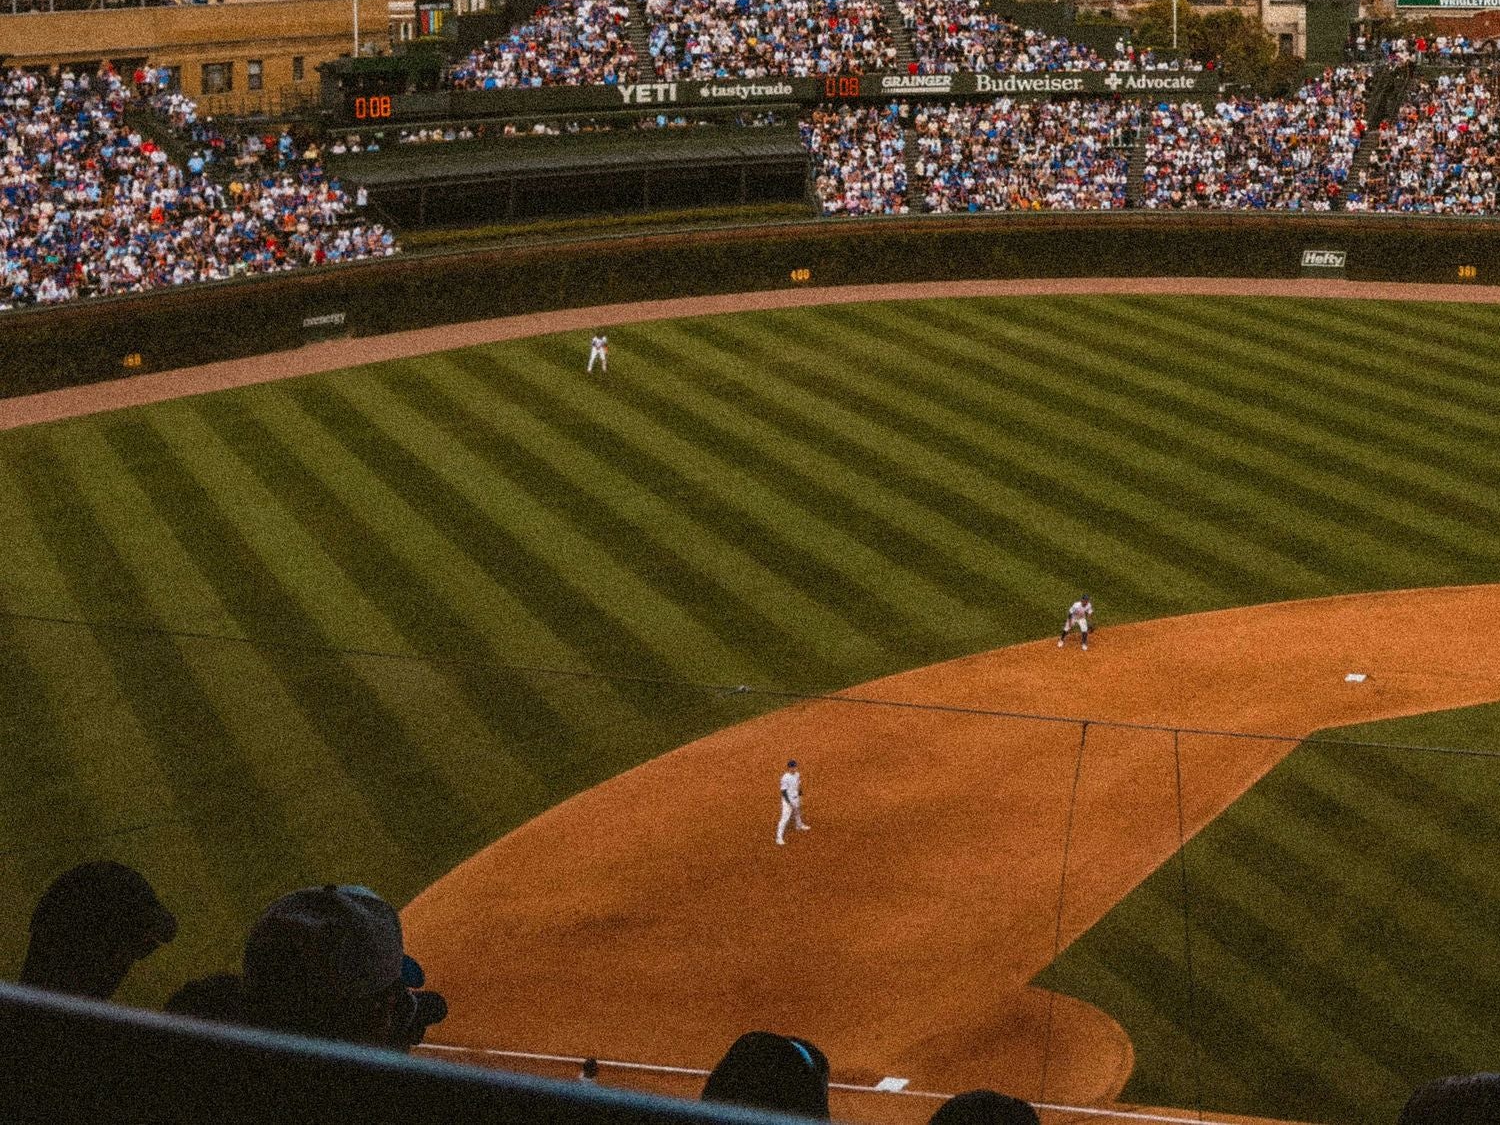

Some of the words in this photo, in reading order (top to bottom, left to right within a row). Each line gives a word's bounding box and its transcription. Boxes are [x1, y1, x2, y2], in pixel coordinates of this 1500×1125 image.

[882, 76, 951, 87] GRAINGER
[976, 75, 1082, 92] Budweiser
[1125, 75, 1195, 88] Advocate
[618, 83, 677, 103] YETI
[711, 82, 792, 100] tastytrade
[1305, 253, 1343, 267] Hefty
